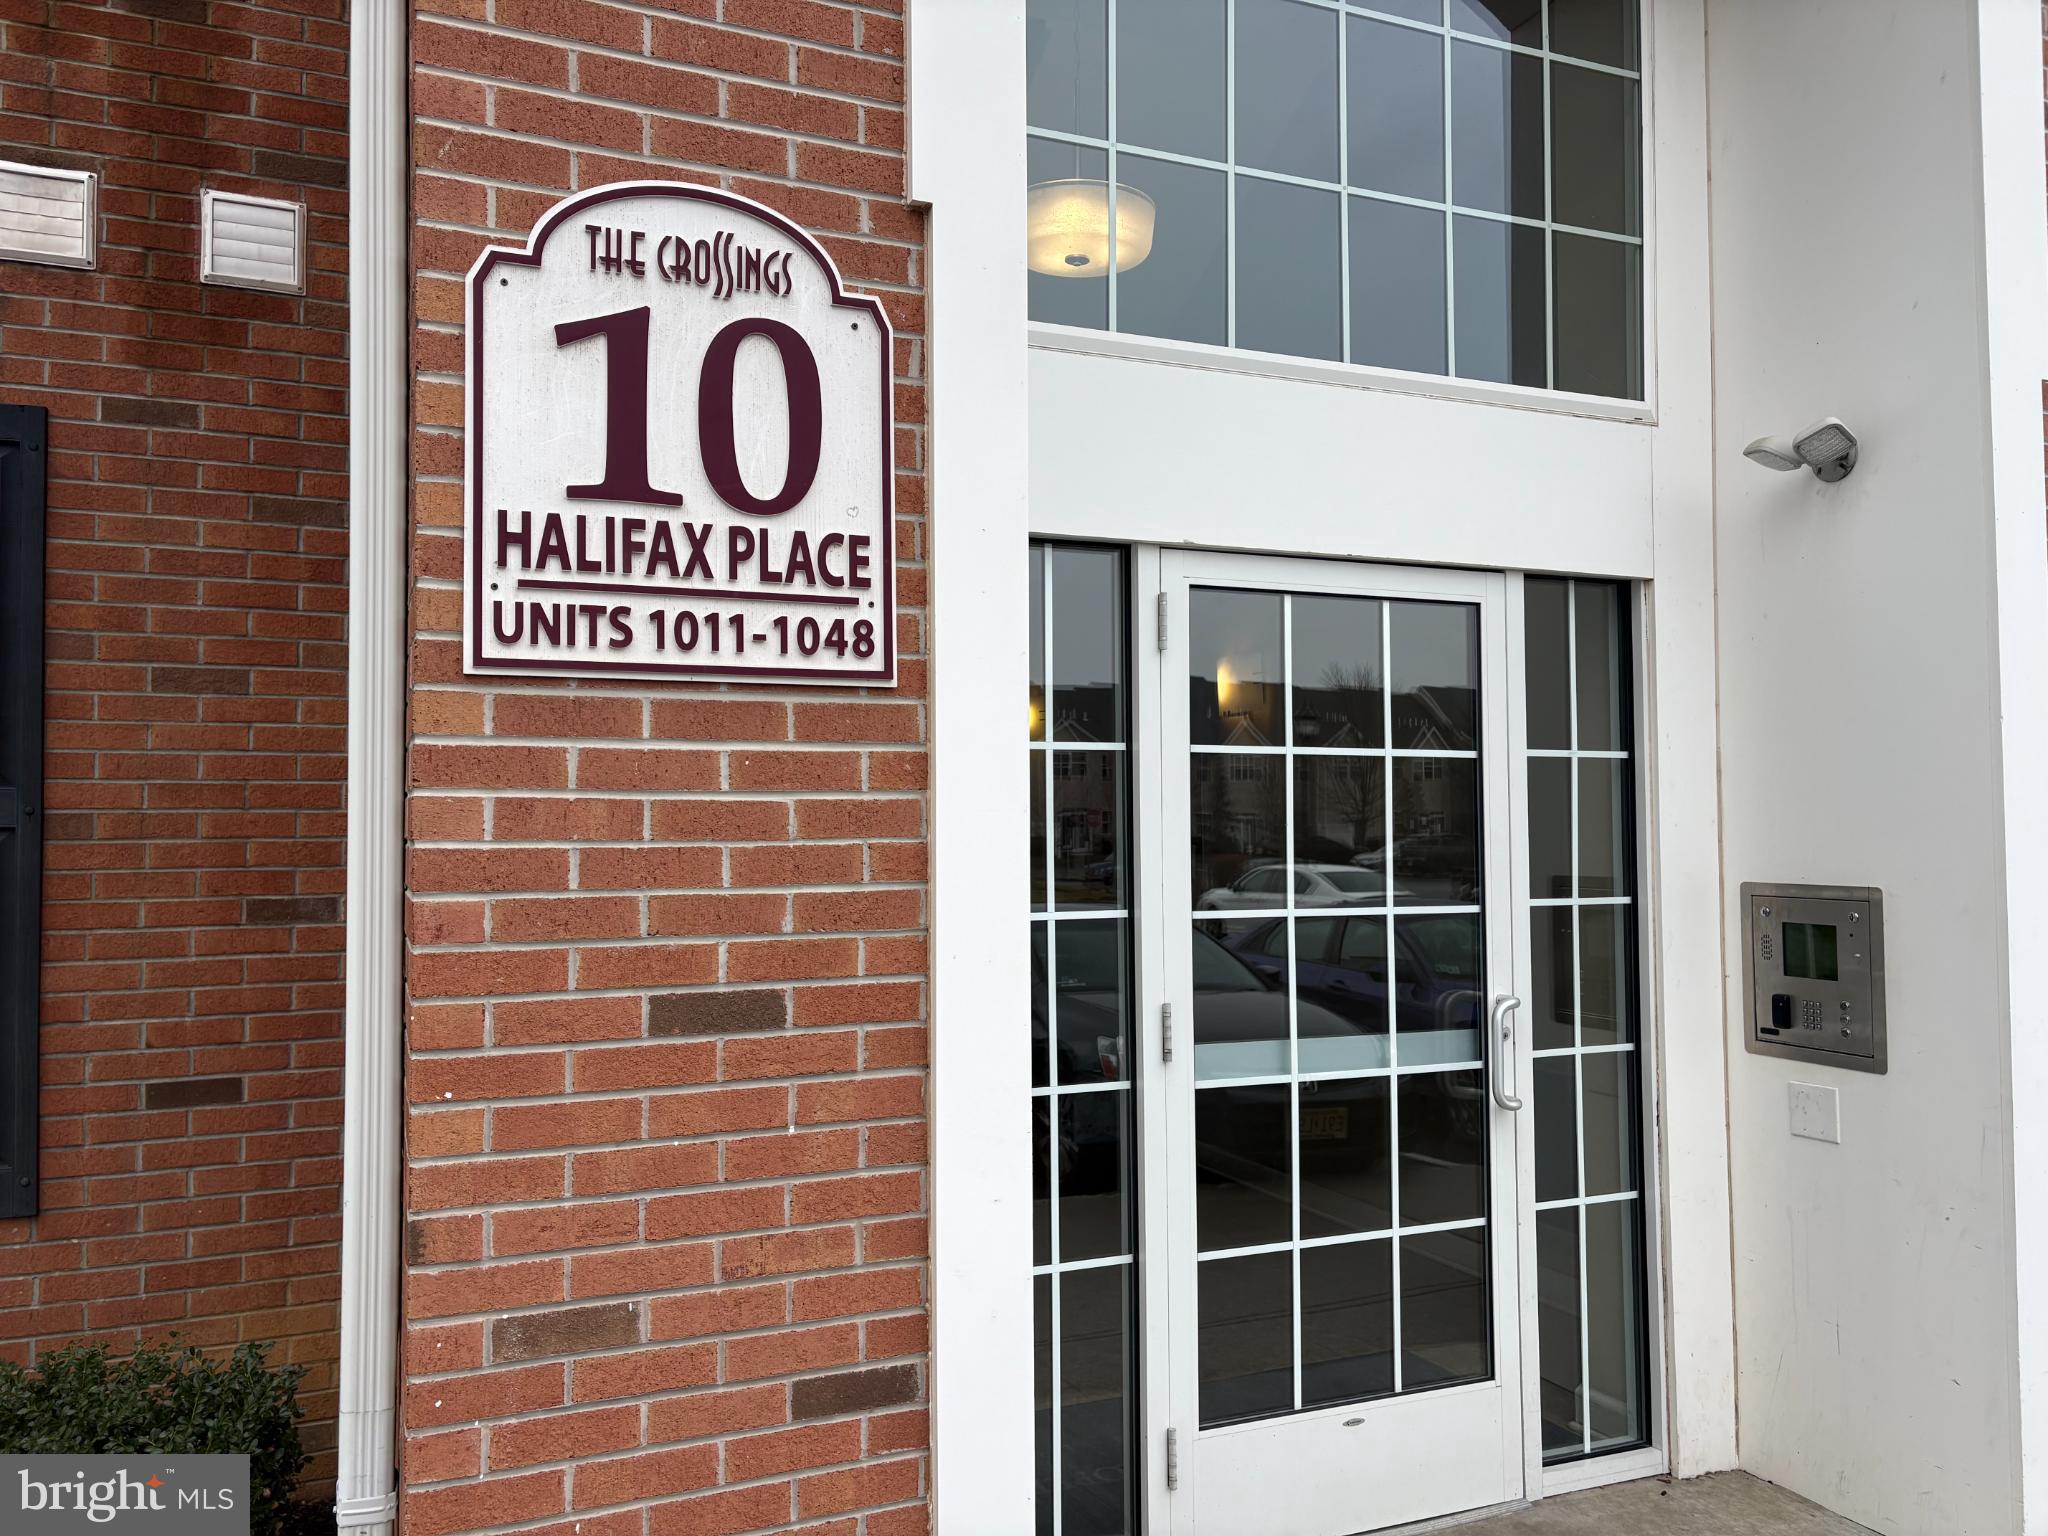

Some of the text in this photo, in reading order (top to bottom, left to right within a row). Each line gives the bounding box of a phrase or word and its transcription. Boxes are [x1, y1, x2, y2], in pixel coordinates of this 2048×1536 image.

[585, 224, 793, 299] THE CROSSINGS
[554, 305, 823, 516] 10
[497, 509, 872, 590] HALIFAX PLACE
[493, 600, 875, 659] UNITS 1011-1048
